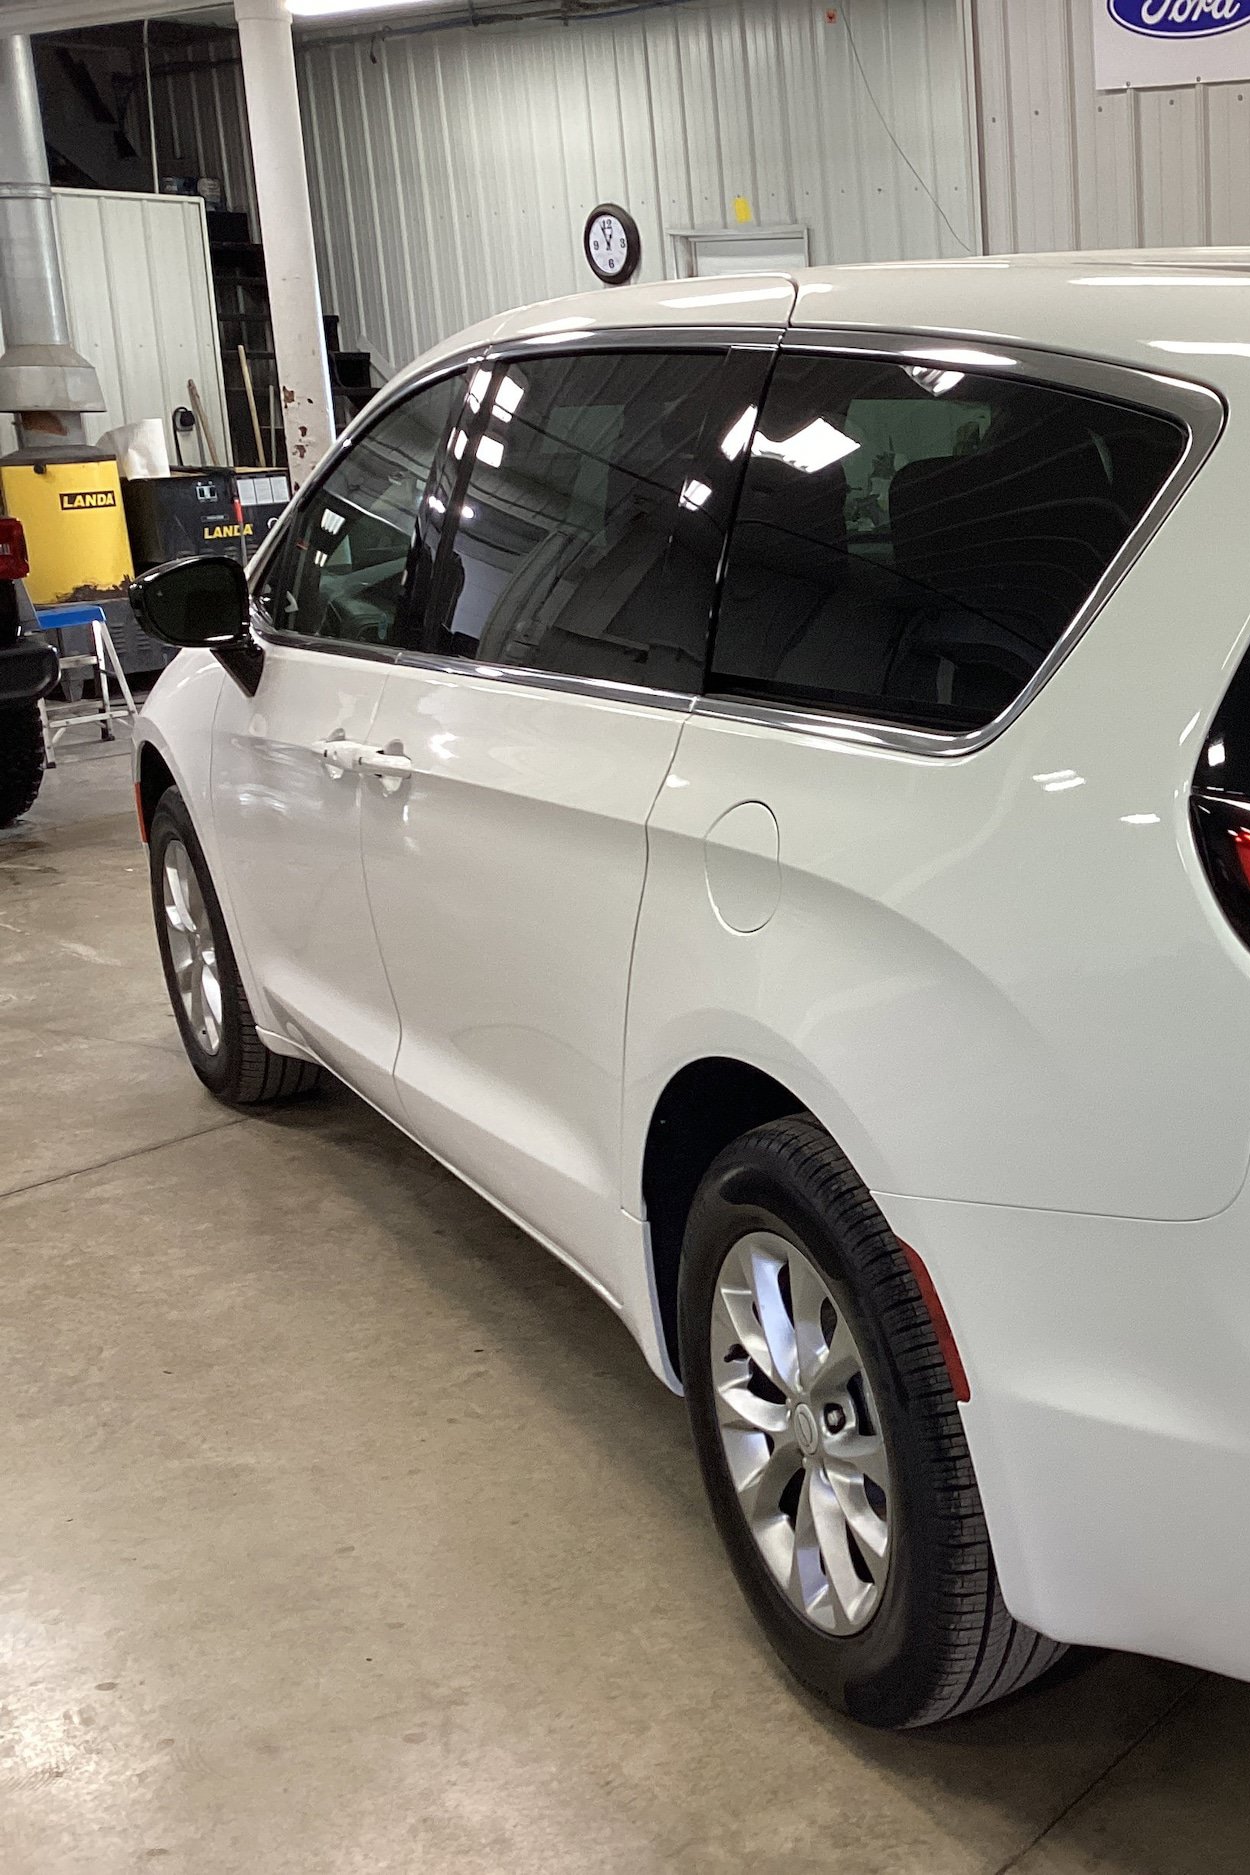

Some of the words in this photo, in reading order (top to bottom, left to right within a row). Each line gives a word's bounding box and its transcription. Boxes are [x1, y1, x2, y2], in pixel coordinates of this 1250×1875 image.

[602, 219, 612, 230] 12
[593, 240, 600, 251] 9
[619, 238, 626, 249] 3
[608, 258, 615, 269] 6
[61, 492, 115, 508] LANDA
